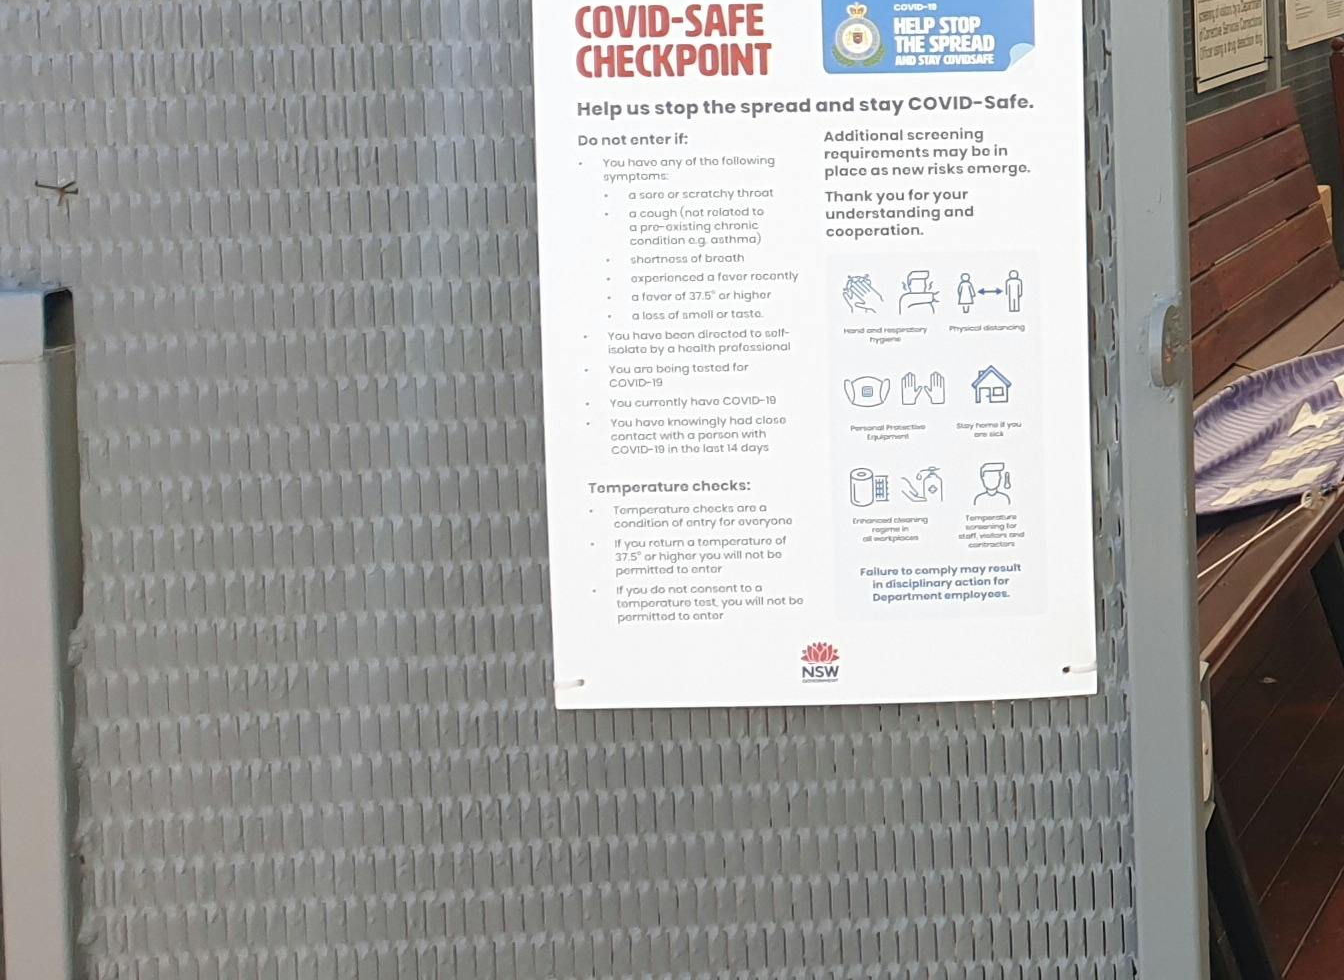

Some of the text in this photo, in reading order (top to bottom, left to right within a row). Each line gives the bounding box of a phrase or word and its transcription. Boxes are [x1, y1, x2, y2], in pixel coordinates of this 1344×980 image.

[575, 4, 764, 39] COVID-SAFE
[894, 16, 980, 34] HELP STOP
[895, 35, 995, 53] THE SPREAD
[576, 43, 772, 78] CHECKPOINT
[578, 94, 1033, 120] Help us stop the spread and stay COVID-Safe.
[578, 133, 688, 146] Do not enter if:
[824, 128, 983, 143] Additional screening
[825, 144, 1007, 162] requirements may be in
[603, 159, 625, 167] You
[660, 159, 682, 169] any
[686, 157, 696, 166] of
[700, 157, 719, 165] the
[722, 156, 775, 167] following
[825, 164, 1030, 180] place as new risks emerge.
[825, 189, 968, 205] Thank you for your
[826, 206, 973, 221] understanding and
[826, 224, 923, 240] cooperation.
[588, 480, 750, 497] Temperature checks:
[860, 563, 1021, 577] Failure to comply may result
[886, 579, 952, 590] disciplinary
[955, 578, 991, 586] action
[993, 577, 1009, 585] for
[873, 591, 1010, 604] Department employees.
[802, 666, 839, 680] NSW
